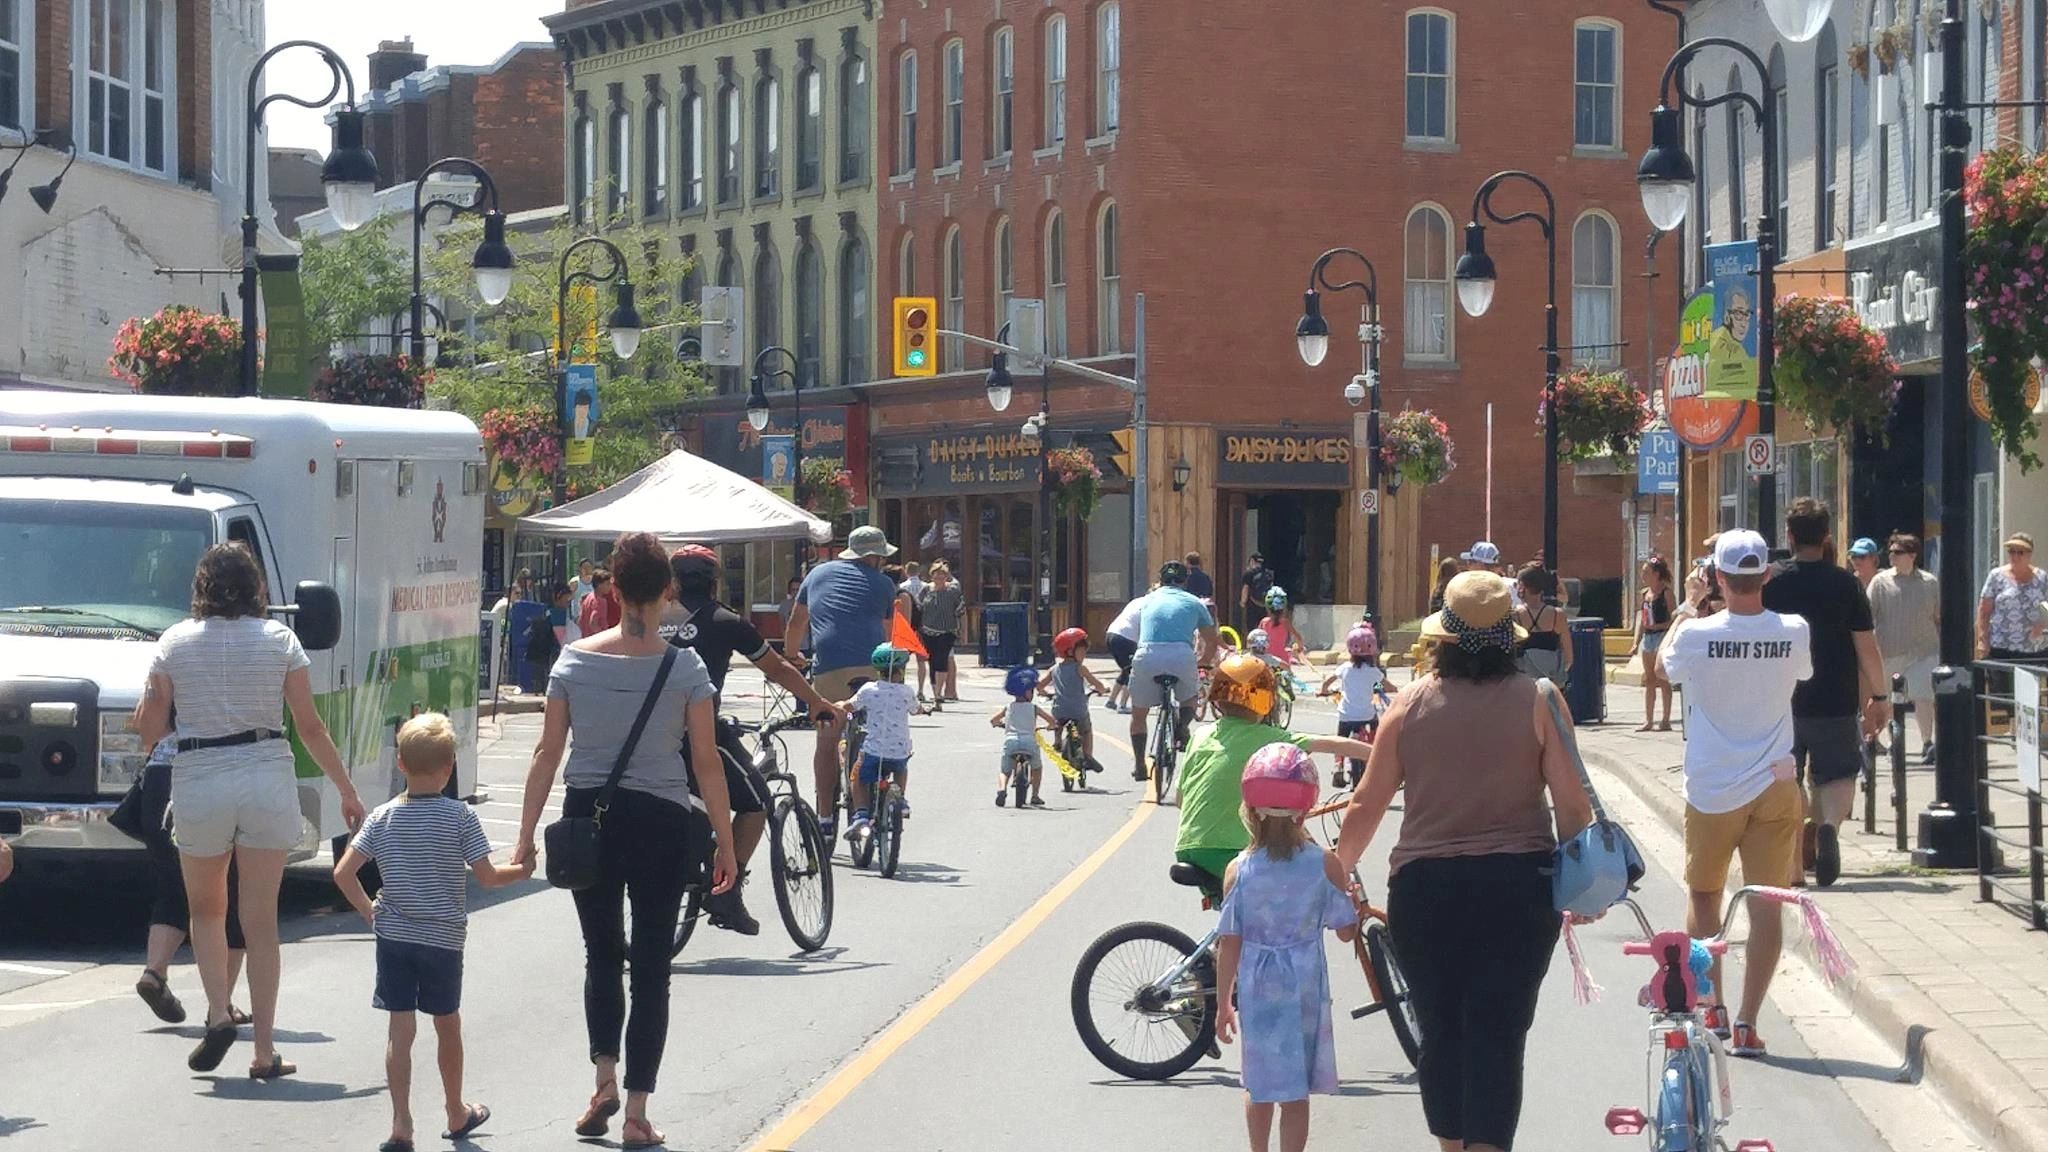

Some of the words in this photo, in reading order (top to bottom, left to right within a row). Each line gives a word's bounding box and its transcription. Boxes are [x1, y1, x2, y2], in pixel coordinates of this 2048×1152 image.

[1902, 270, 1941, 332] City
[930, 437, 978, 464] DAISY
[985, 433, 1042, 460] DUKES
[1226, 437, 1279, 461] DAISY
[1281, 437, 1350, 462] DUKES
[1652, 434, 1676, 454] Pu
[951, 464, 975, 482] Boots
[988, 462, 1025, 482] Bourbon
[391, 586, 423, 612] MEDICAL
[426, 583, 444, 608] FIRST
[1707, 641, 1750, 659] EVENT
[1753, 641, 1792, 659] STAFF
